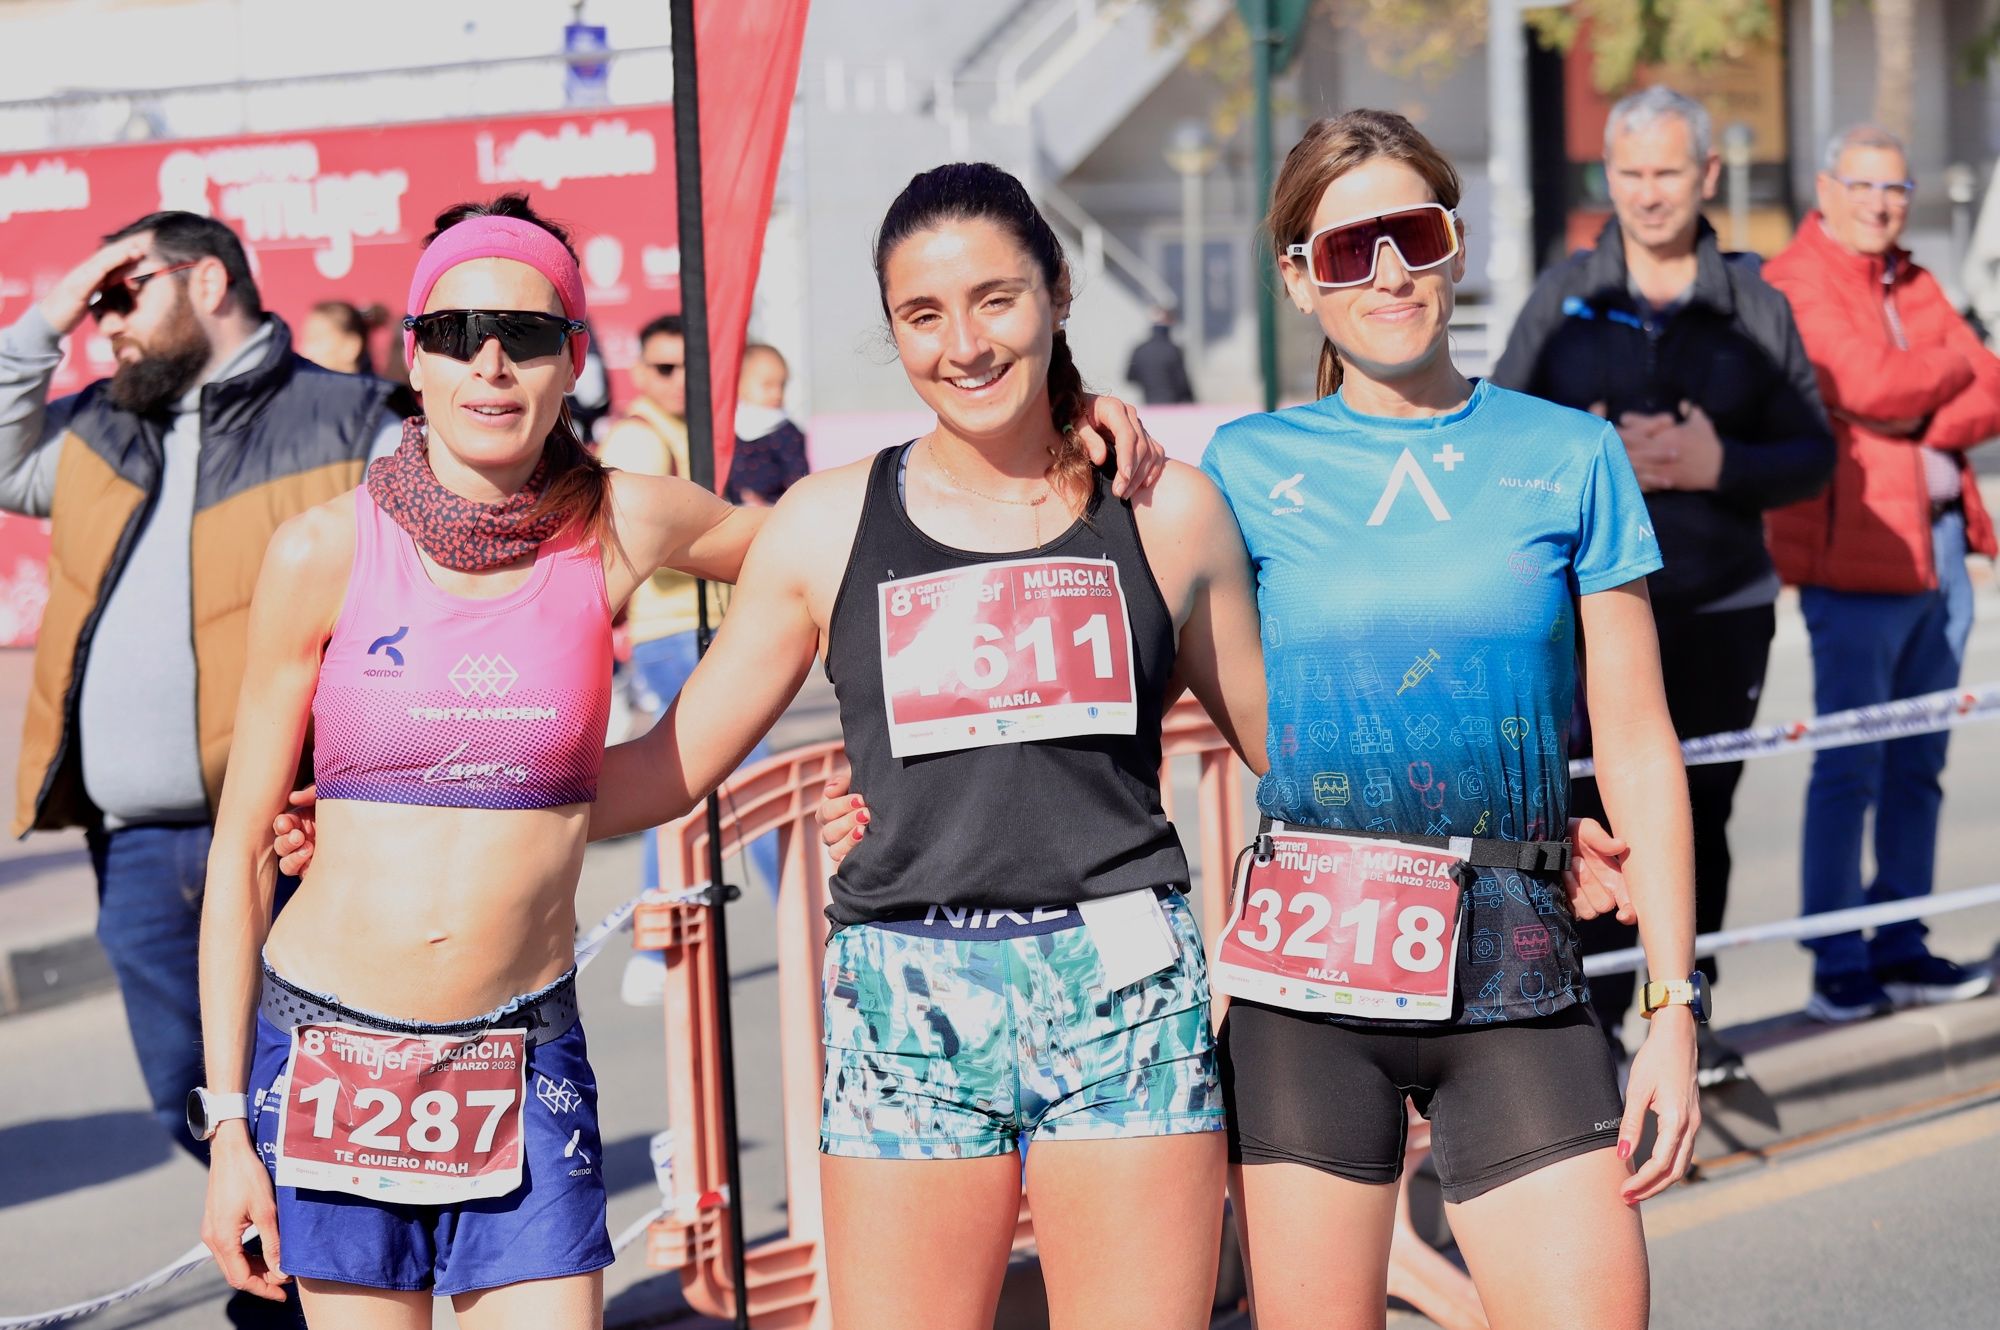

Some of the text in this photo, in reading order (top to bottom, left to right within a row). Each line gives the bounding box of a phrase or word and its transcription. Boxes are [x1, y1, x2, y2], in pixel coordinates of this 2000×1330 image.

[1499, 477, 1561, 493] AULAPLUS
[1023, 569, 1108, 589] MURCIA
[1034, 590, 1048, 599] DE
[1051, 588, 1087, 597] MARZO
[1089, 588, 1112, 597] 2023
[989, 691, 1042, 709] MARÍA
[409, 707, 556, 720] TRITANDEM
[424, 741, 529, 783] Lazarus
[1273, 841, 1308, 853] carrera
[1281, 852, 1344, 884] mujer
[1363, 851, 1451, 879] MURCIA
[1370, 871, 1383, 881] DE
[1386, 874, 1424, 886] MARZO
[1425, 879, 1451, 890] 2023
[1238, 888, 1446, 972] 3218
[1306, 967, 1349, 984] MAZA
[340, 1043, 415, 1080] mujer
[432, 1042, 515, 1064] MURCIA
[437, 1062, 449, 1072] DE
[452, 1062, 489, 1071] MARZO
[492, 1060, 516, 1070] 2023
[299, 1077, 516, 1153] 1287
[334, 1150, 469, 1174] TE QUIERO NOAH
